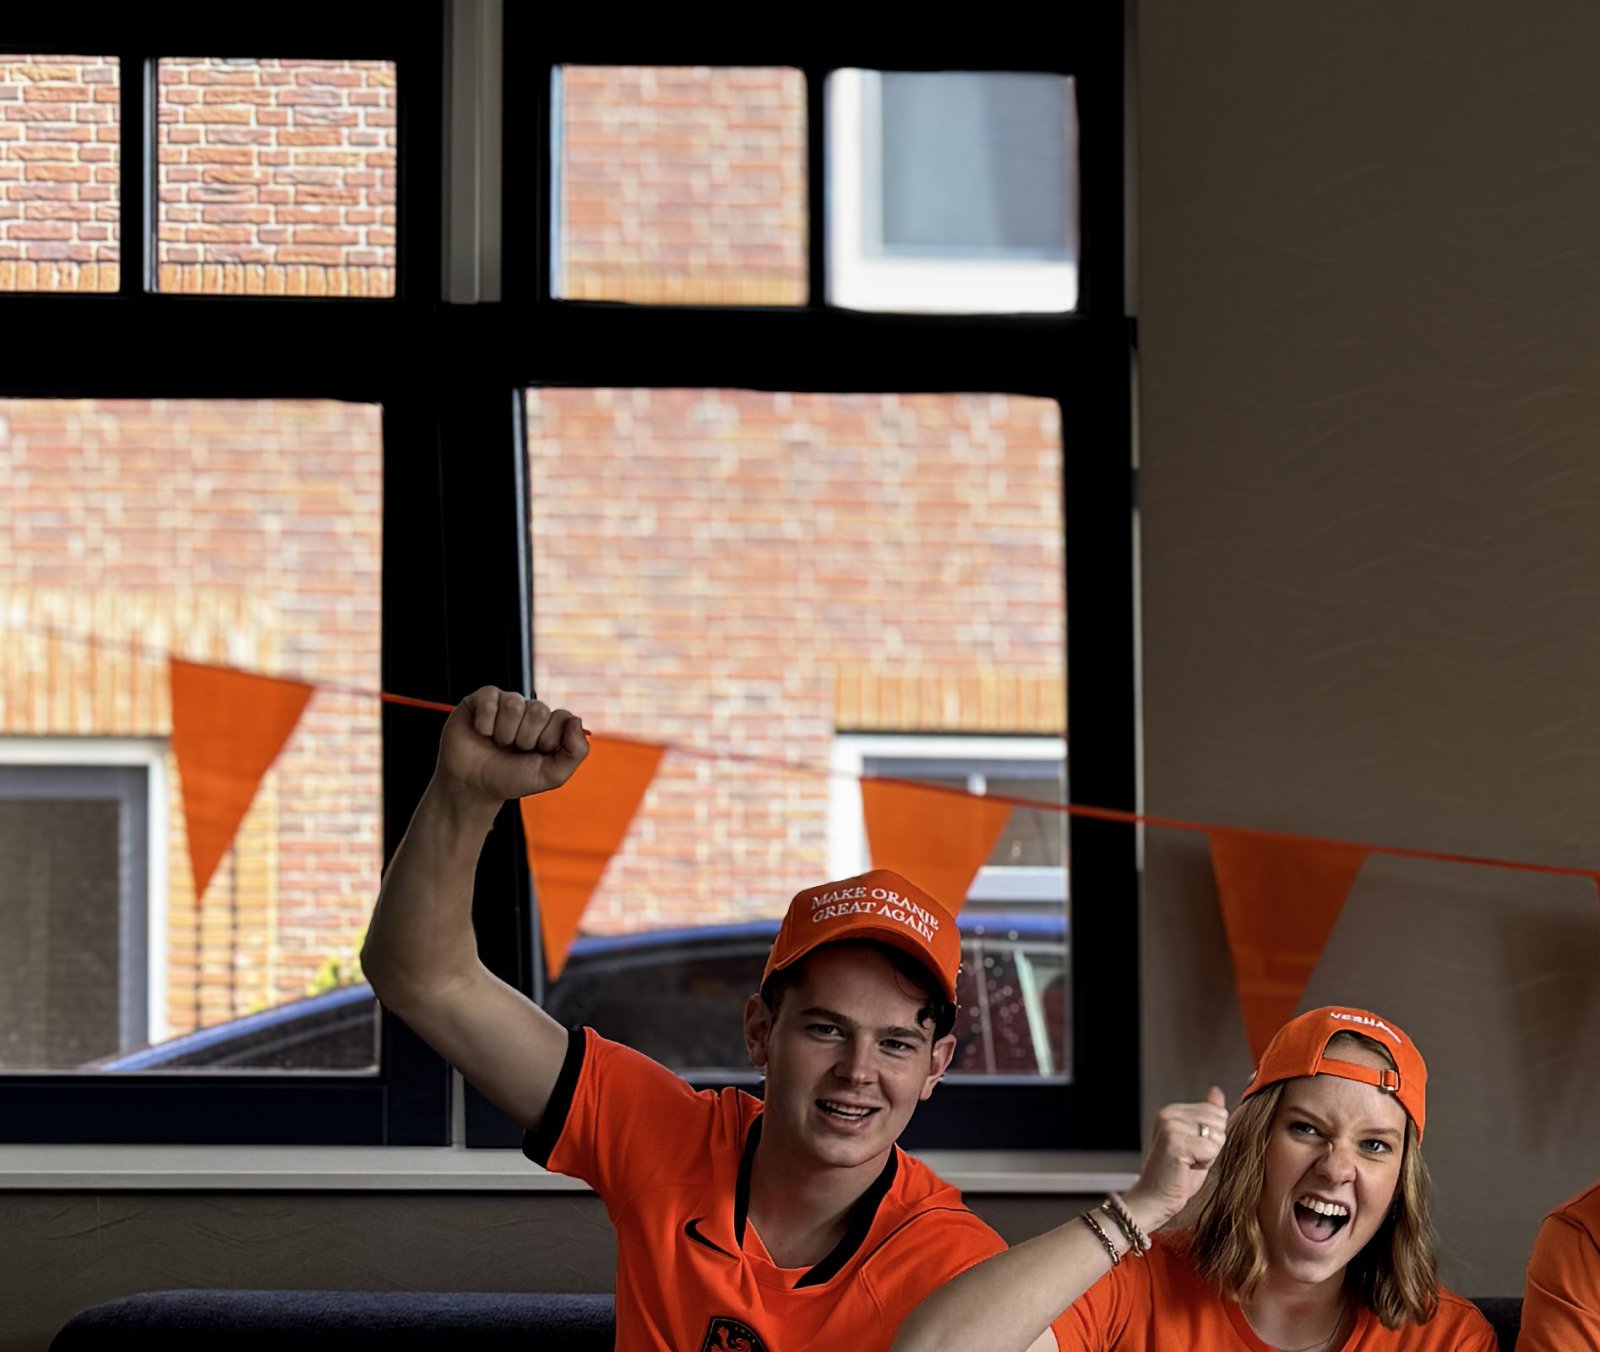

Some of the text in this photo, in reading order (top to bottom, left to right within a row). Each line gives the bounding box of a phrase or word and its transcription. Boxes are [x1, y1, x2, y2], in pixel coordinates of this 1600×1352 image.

[811, 887, 867, 910] MAKE
[812, 901, 935, 943] GREAT AGAIN
